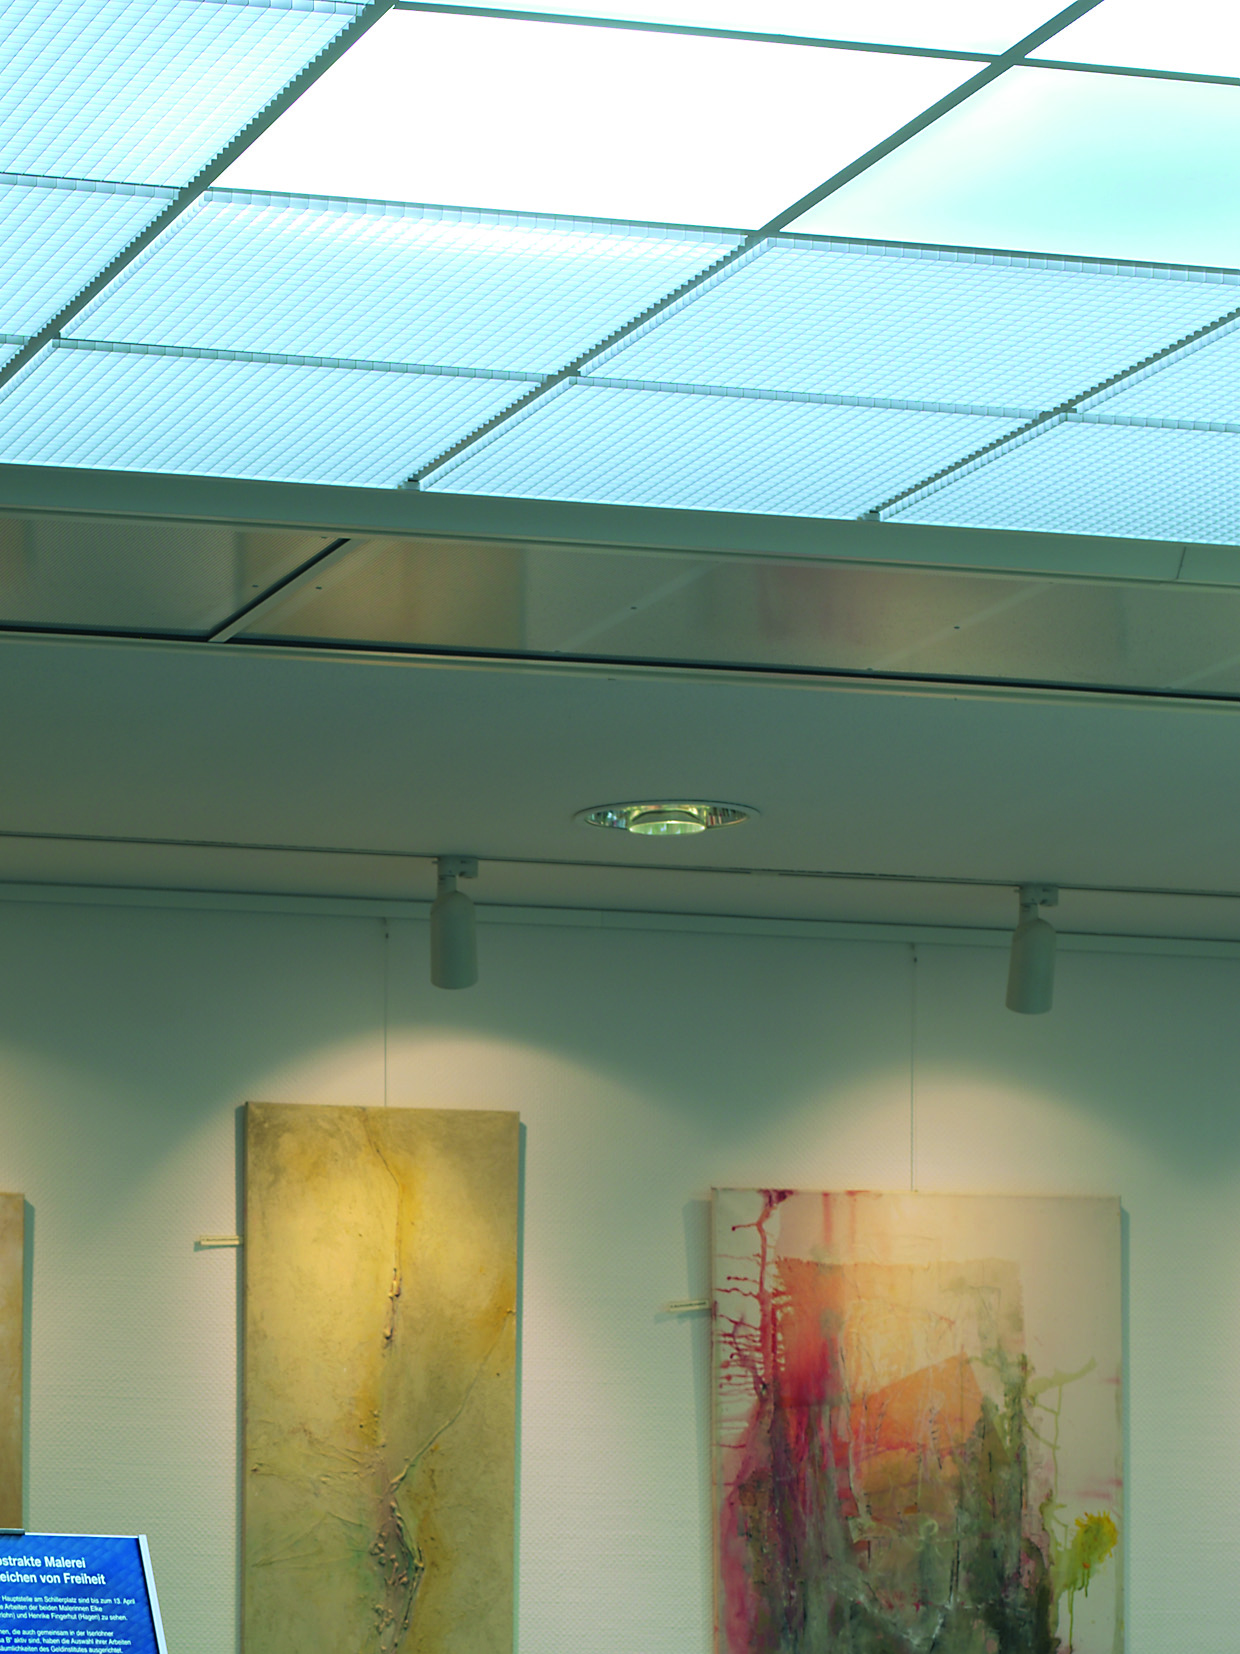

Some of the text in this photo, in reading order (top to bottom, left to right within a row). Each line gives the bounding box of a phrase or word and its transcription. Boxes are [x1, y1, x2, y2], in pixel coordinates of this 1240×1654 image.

[44, 1556, 86, 1568] Malerei
[40, 1574, 61, 1583] von
[63, 1573, 106, 1585] Freiheit
[2, 1595, 32, 1603] Hauptstelle
[44, 1596, 76, 1604] Schillerplatz
[123, 1597, 135, 1605] April
[51, 1612, 77, 1620] Fingerhut
[78, 1612, 100, 1621] (Hagen)
[37, 1629, 68, 1637] gemeinsam
